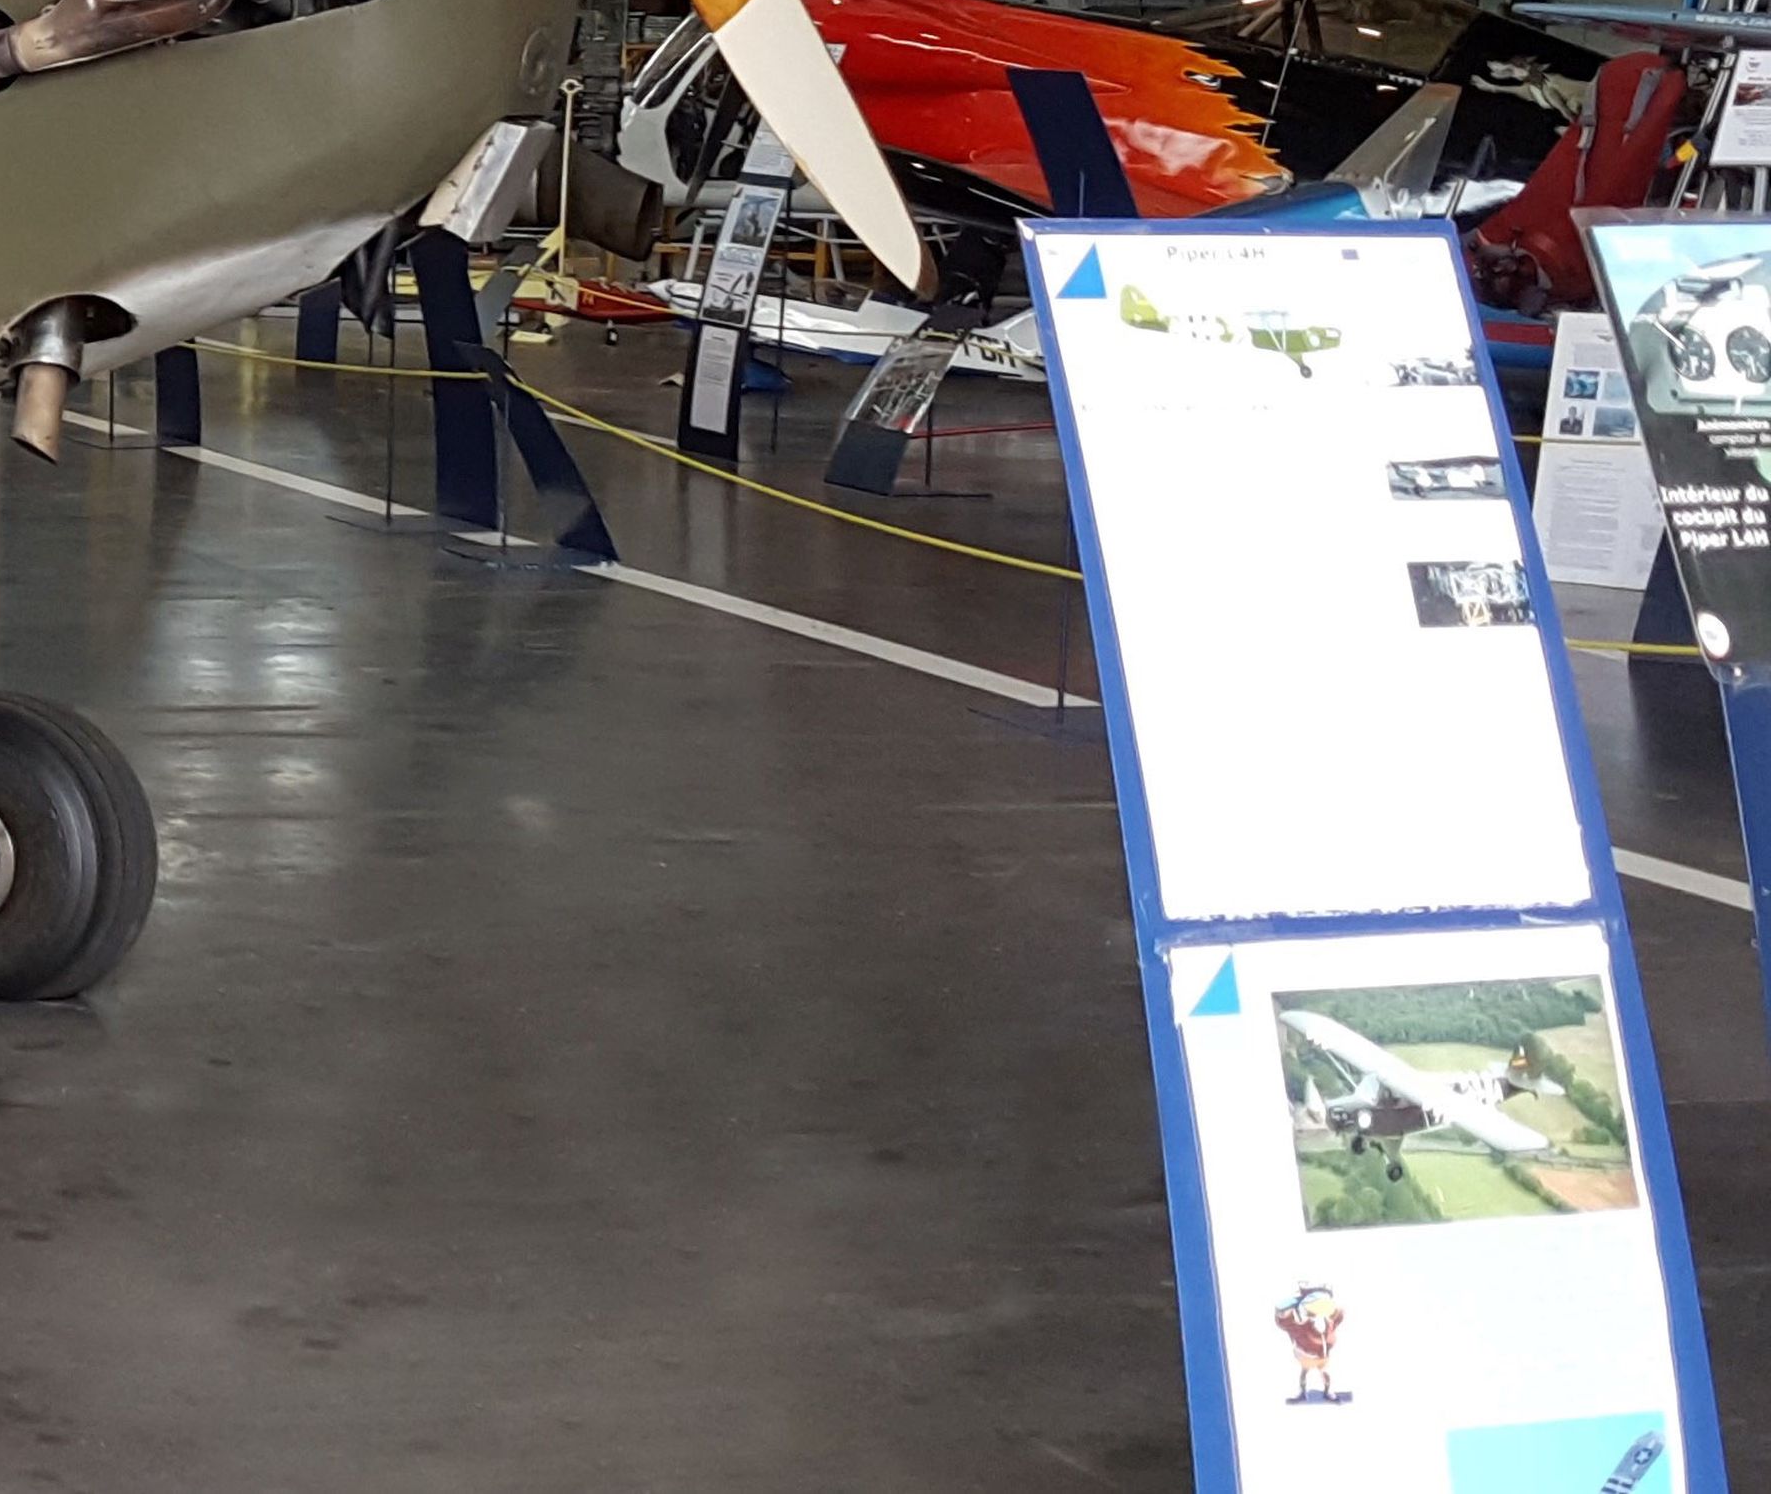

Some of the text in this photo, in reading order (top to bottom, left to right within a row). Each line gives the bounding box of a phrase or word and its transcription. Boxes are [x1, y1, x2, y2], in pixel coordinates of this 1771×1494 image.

[1744, 483, 1770, 503] du
[1672, 506, 1767, 528] cockpit du
[1679, 529, 1729, 551] Piper
